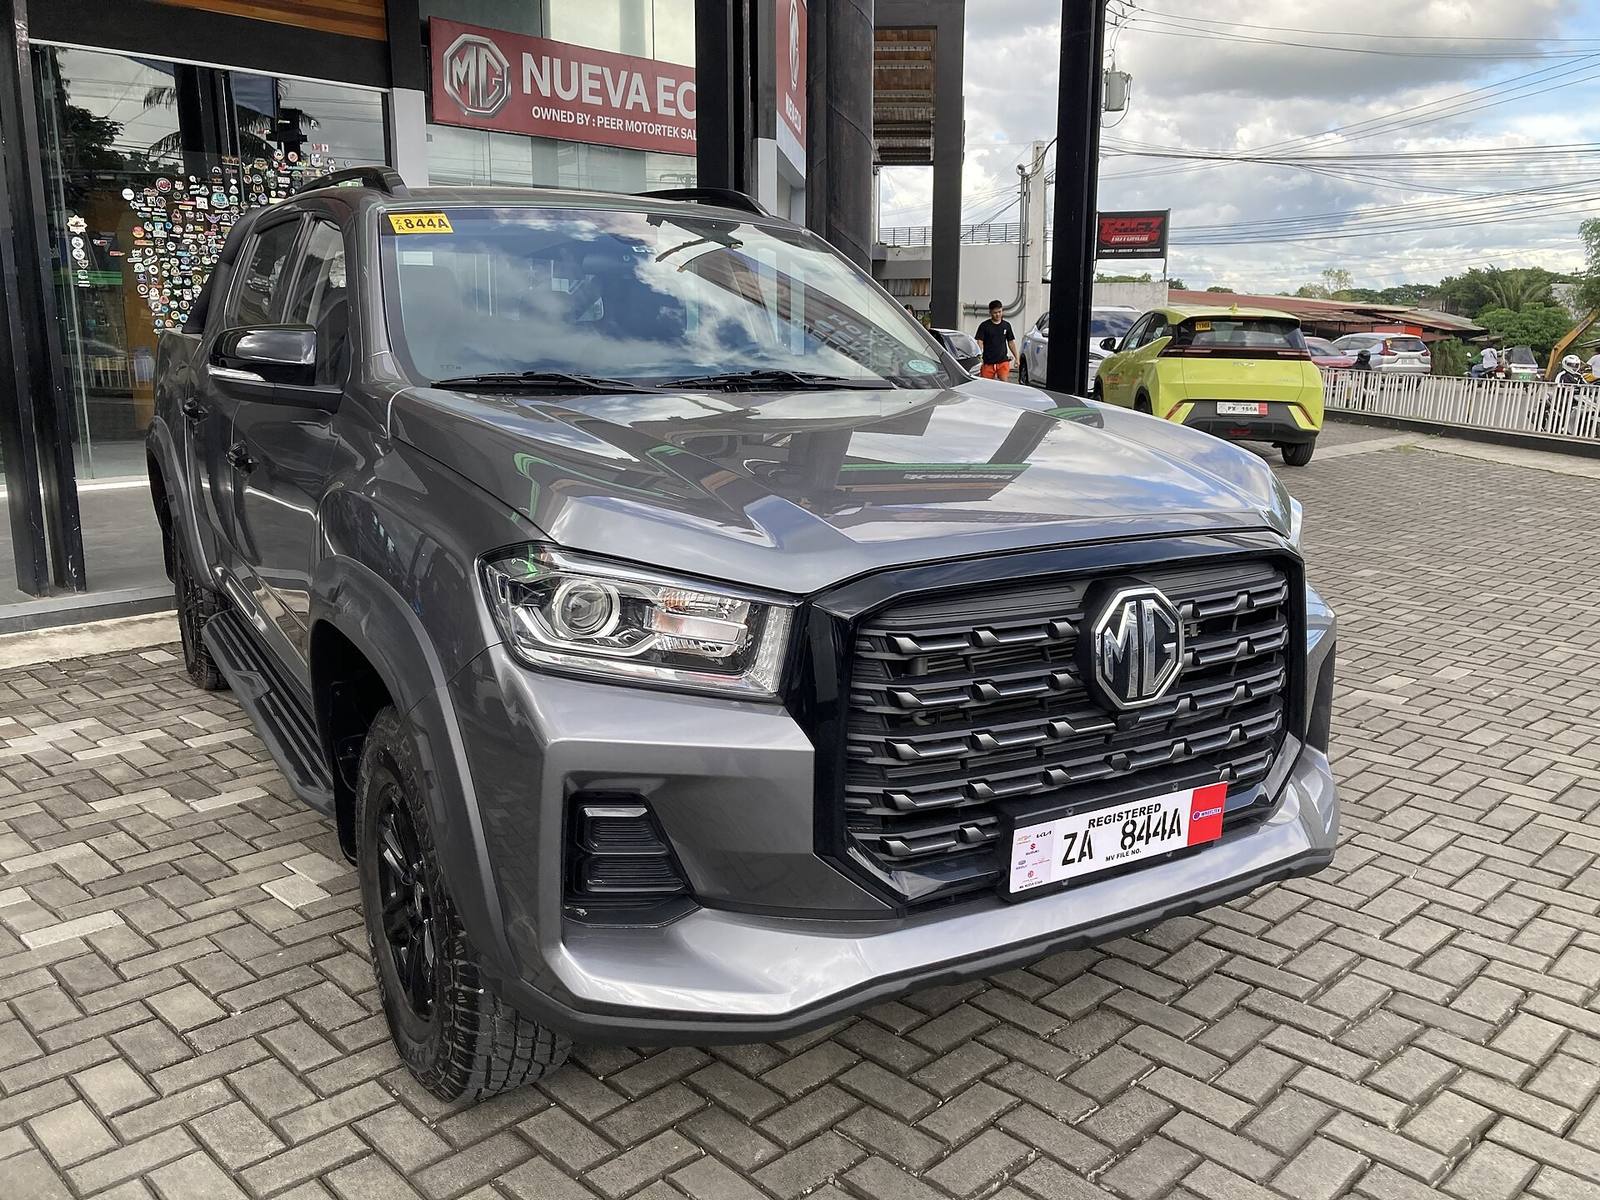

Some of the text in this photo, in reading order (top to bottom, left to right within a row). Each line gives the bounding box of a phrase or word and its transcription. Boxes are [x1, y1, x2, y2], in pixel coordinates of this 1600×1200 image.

[452, 46, 502, 107] MG
[522, 52, 697, 120] NUEVA EC
[531, 106, 575, 124] OWNED
[576, 112, 591, 126] BY
[597, 115, 624, 131] PEER
[625, 120, 680, 138] MOTORTEK
[404, 218, 449, 229] 844A
[1103, 598, 1177, 699] MG
[1062, 808, 1182, 866] ZA 844A
[1088, 803, 1162, 829] REGISTERED
[1116, 850, 1130, 860] FILE
[1131, 848, 1142, 856] NO.
